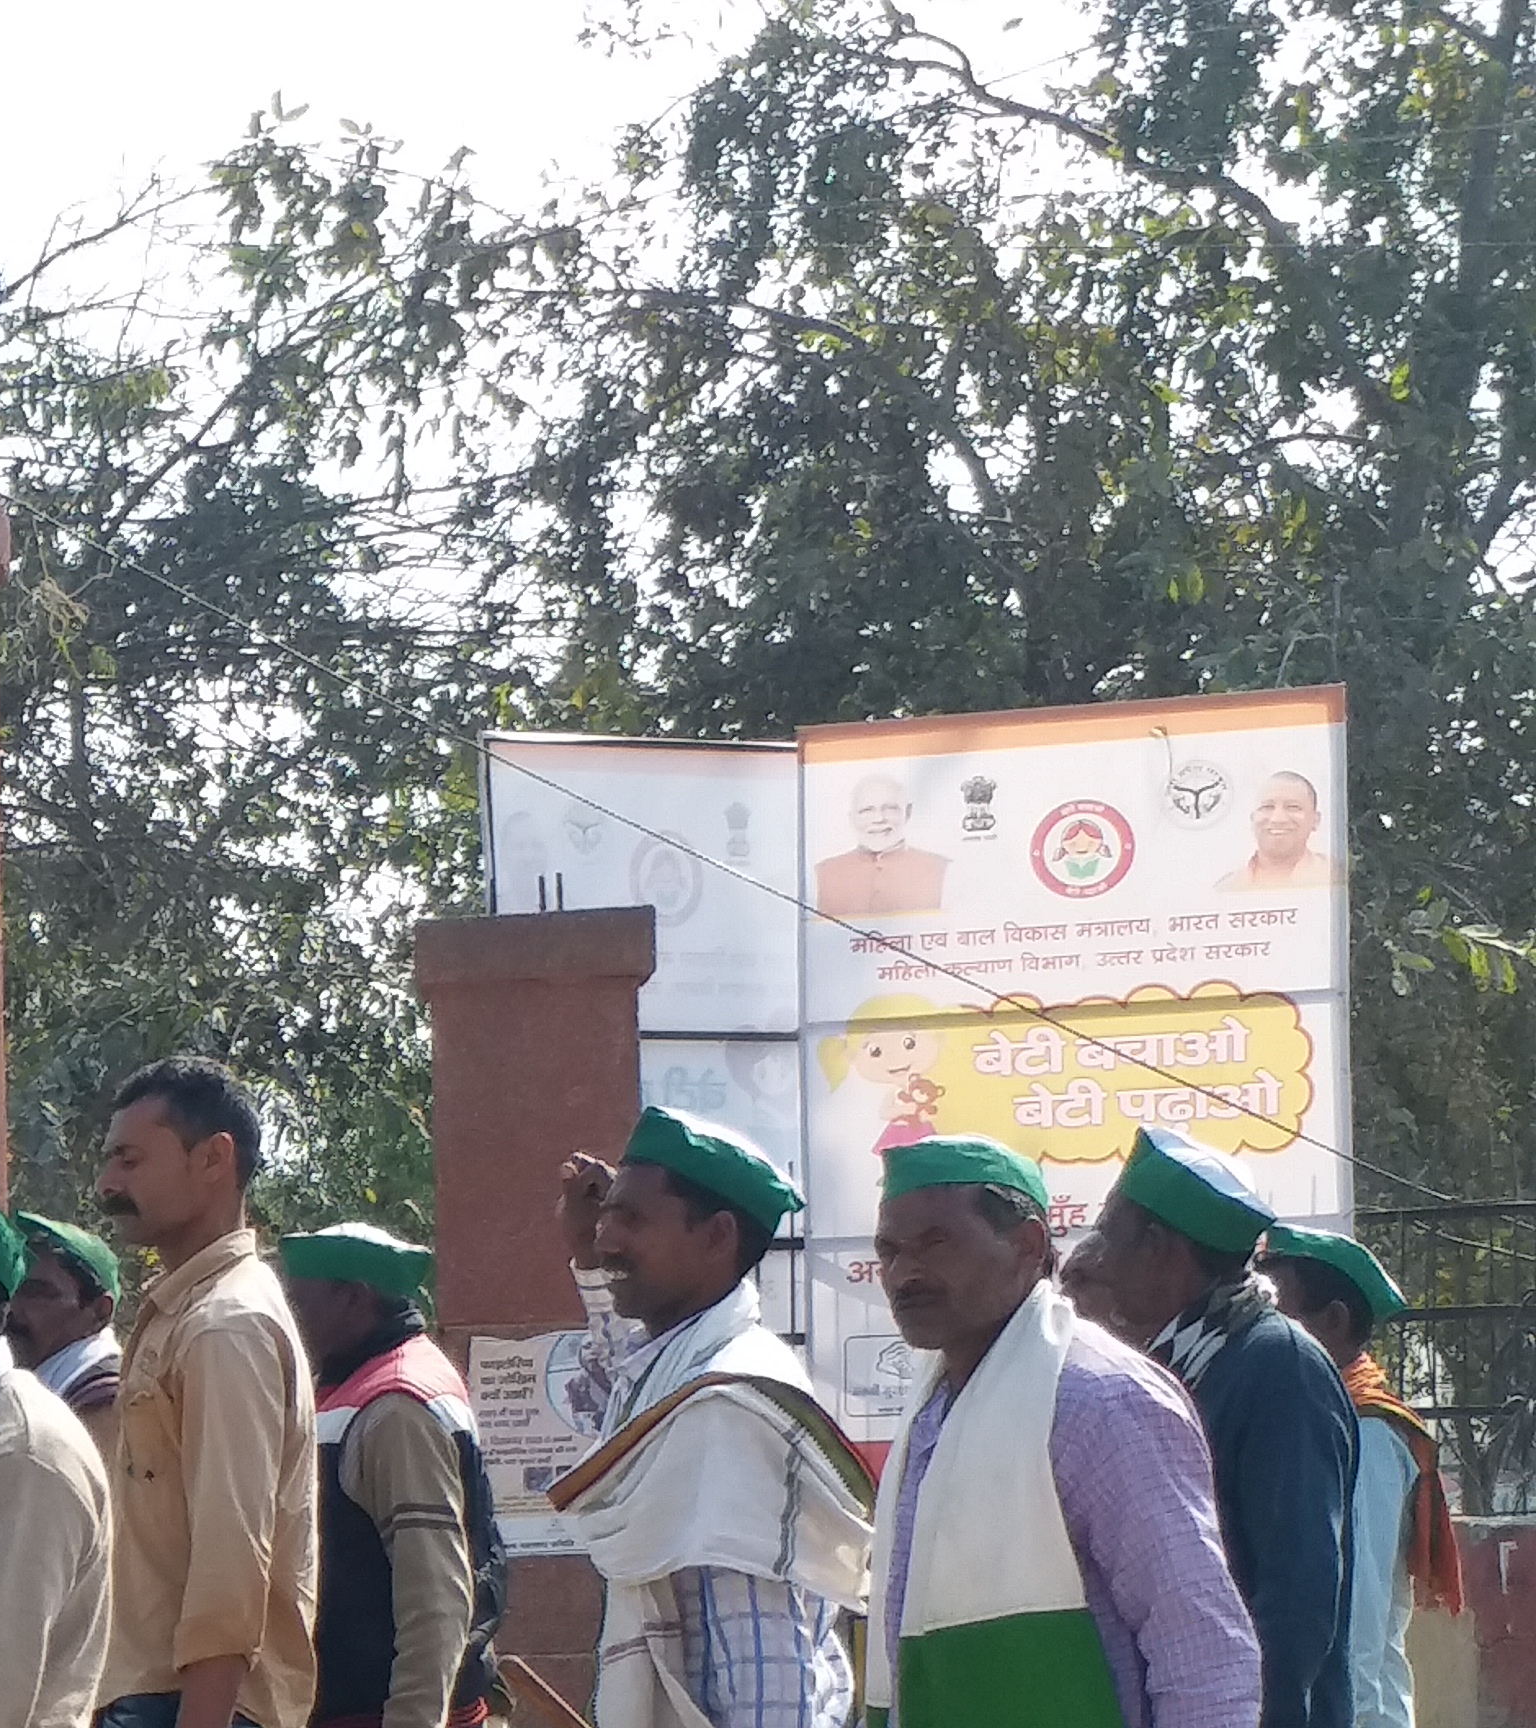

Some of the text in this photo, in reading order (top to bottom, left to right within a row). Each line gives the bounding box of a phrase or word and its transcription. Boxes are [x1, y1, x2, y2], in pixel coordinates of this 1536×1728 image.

[1003, 921, 1068, 943] विकास
[1168, 913, 1220, 932] भारत
[1228, 907, 1298, 930] सरकार
[1150, 942, 1196, 964] प्रदेश
[1203, 940, 1271, 960] सरकार
[973, 1015, 1250, 1077] बेटी बचाओ
[1013, 1078, 1108, 1129] बेटी
